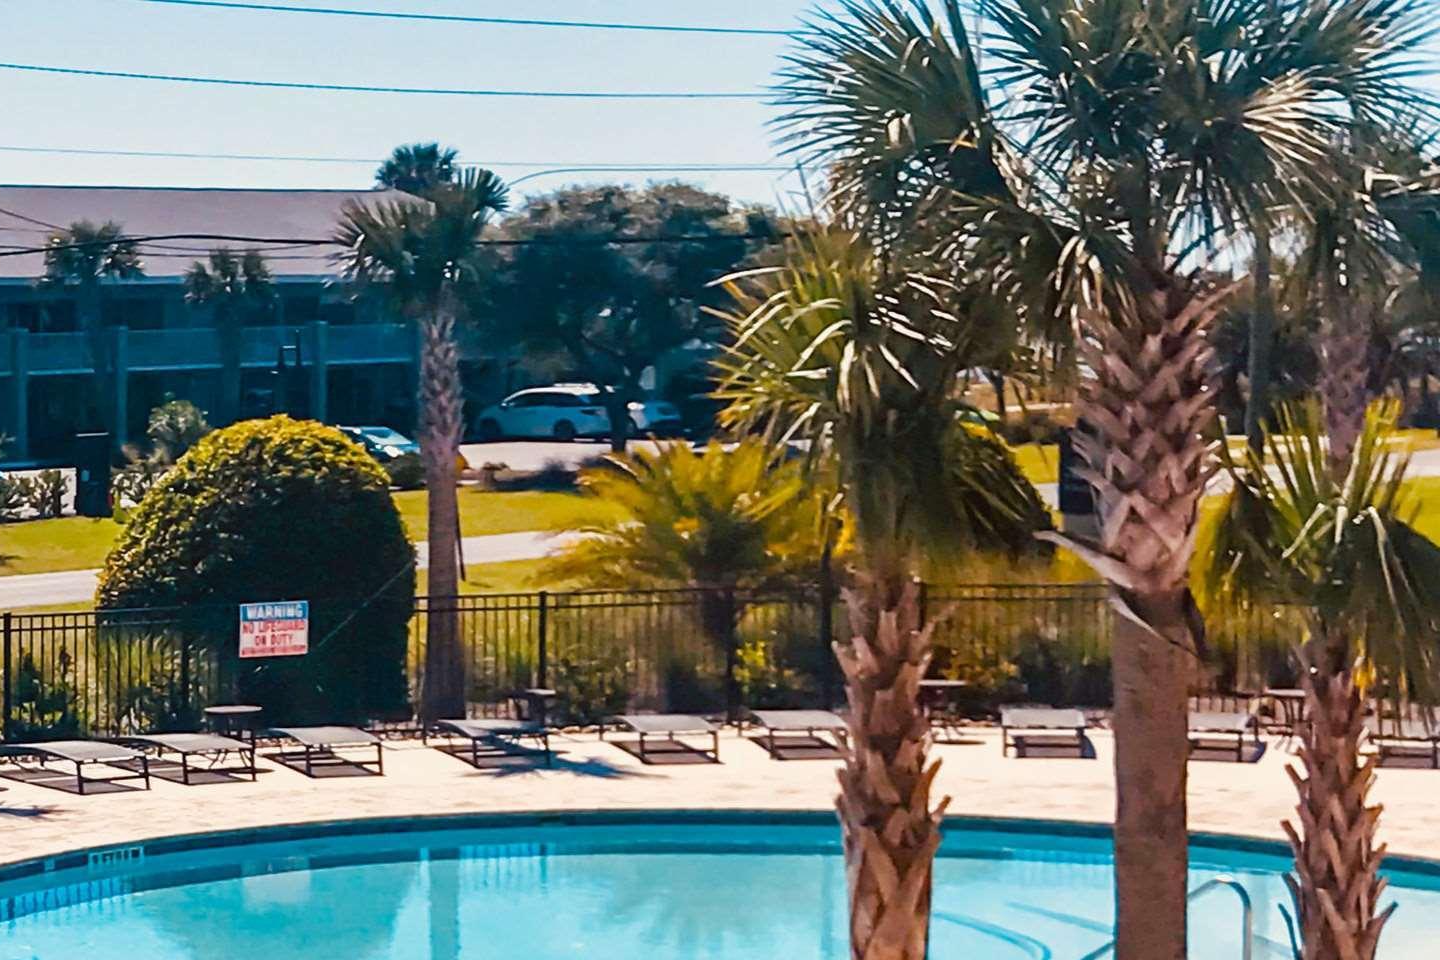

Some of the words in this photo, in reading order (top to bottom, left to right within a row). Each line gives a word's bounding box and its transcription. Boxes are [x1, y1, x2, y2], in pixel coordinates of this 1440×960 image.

[247, 604, 303, 619] WARNING
[243, 623, 254, 634] NO
[255, 635, 267, 646] ON
[271, 634, 294, 646] DUTY
